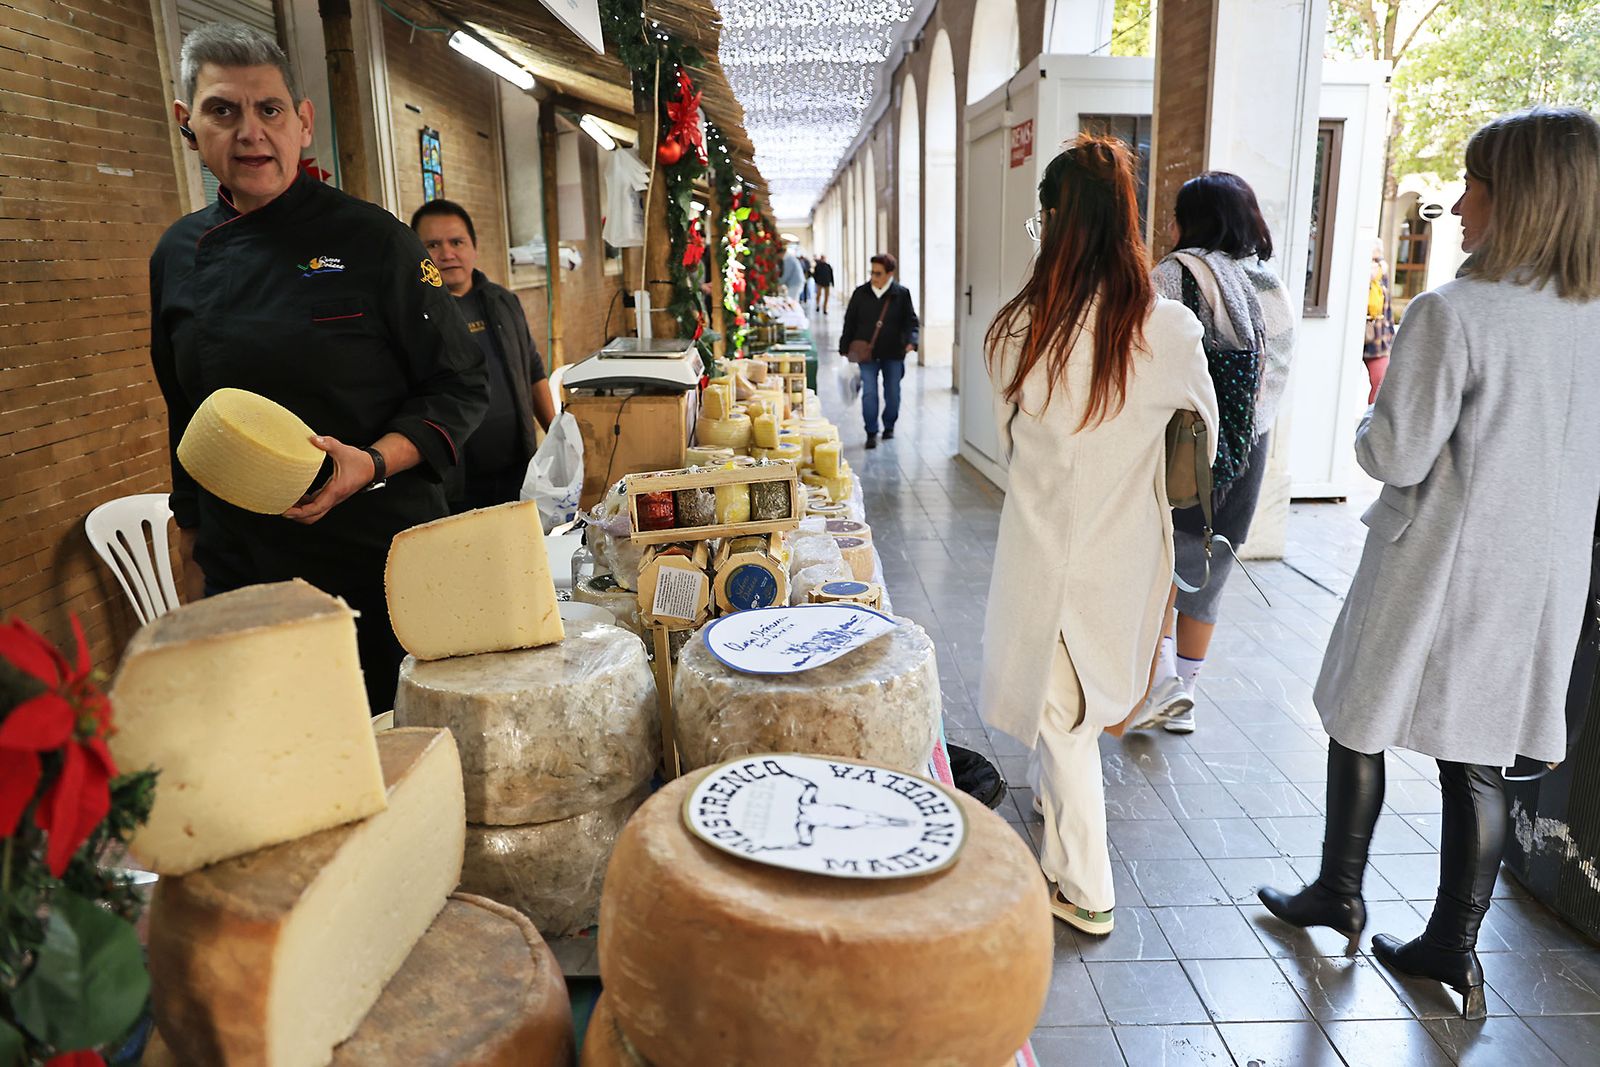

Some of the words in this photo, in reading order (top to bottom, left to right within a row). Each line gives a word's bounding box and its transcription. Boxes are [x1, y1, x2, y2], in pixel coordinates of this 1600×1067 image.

[699, 760, 784, 854] MOSTRENCO
[829, 764, 950, 817] HUELVA
[921, 822, 955, 846] IN
[824, 847, 938, 873] MADE
